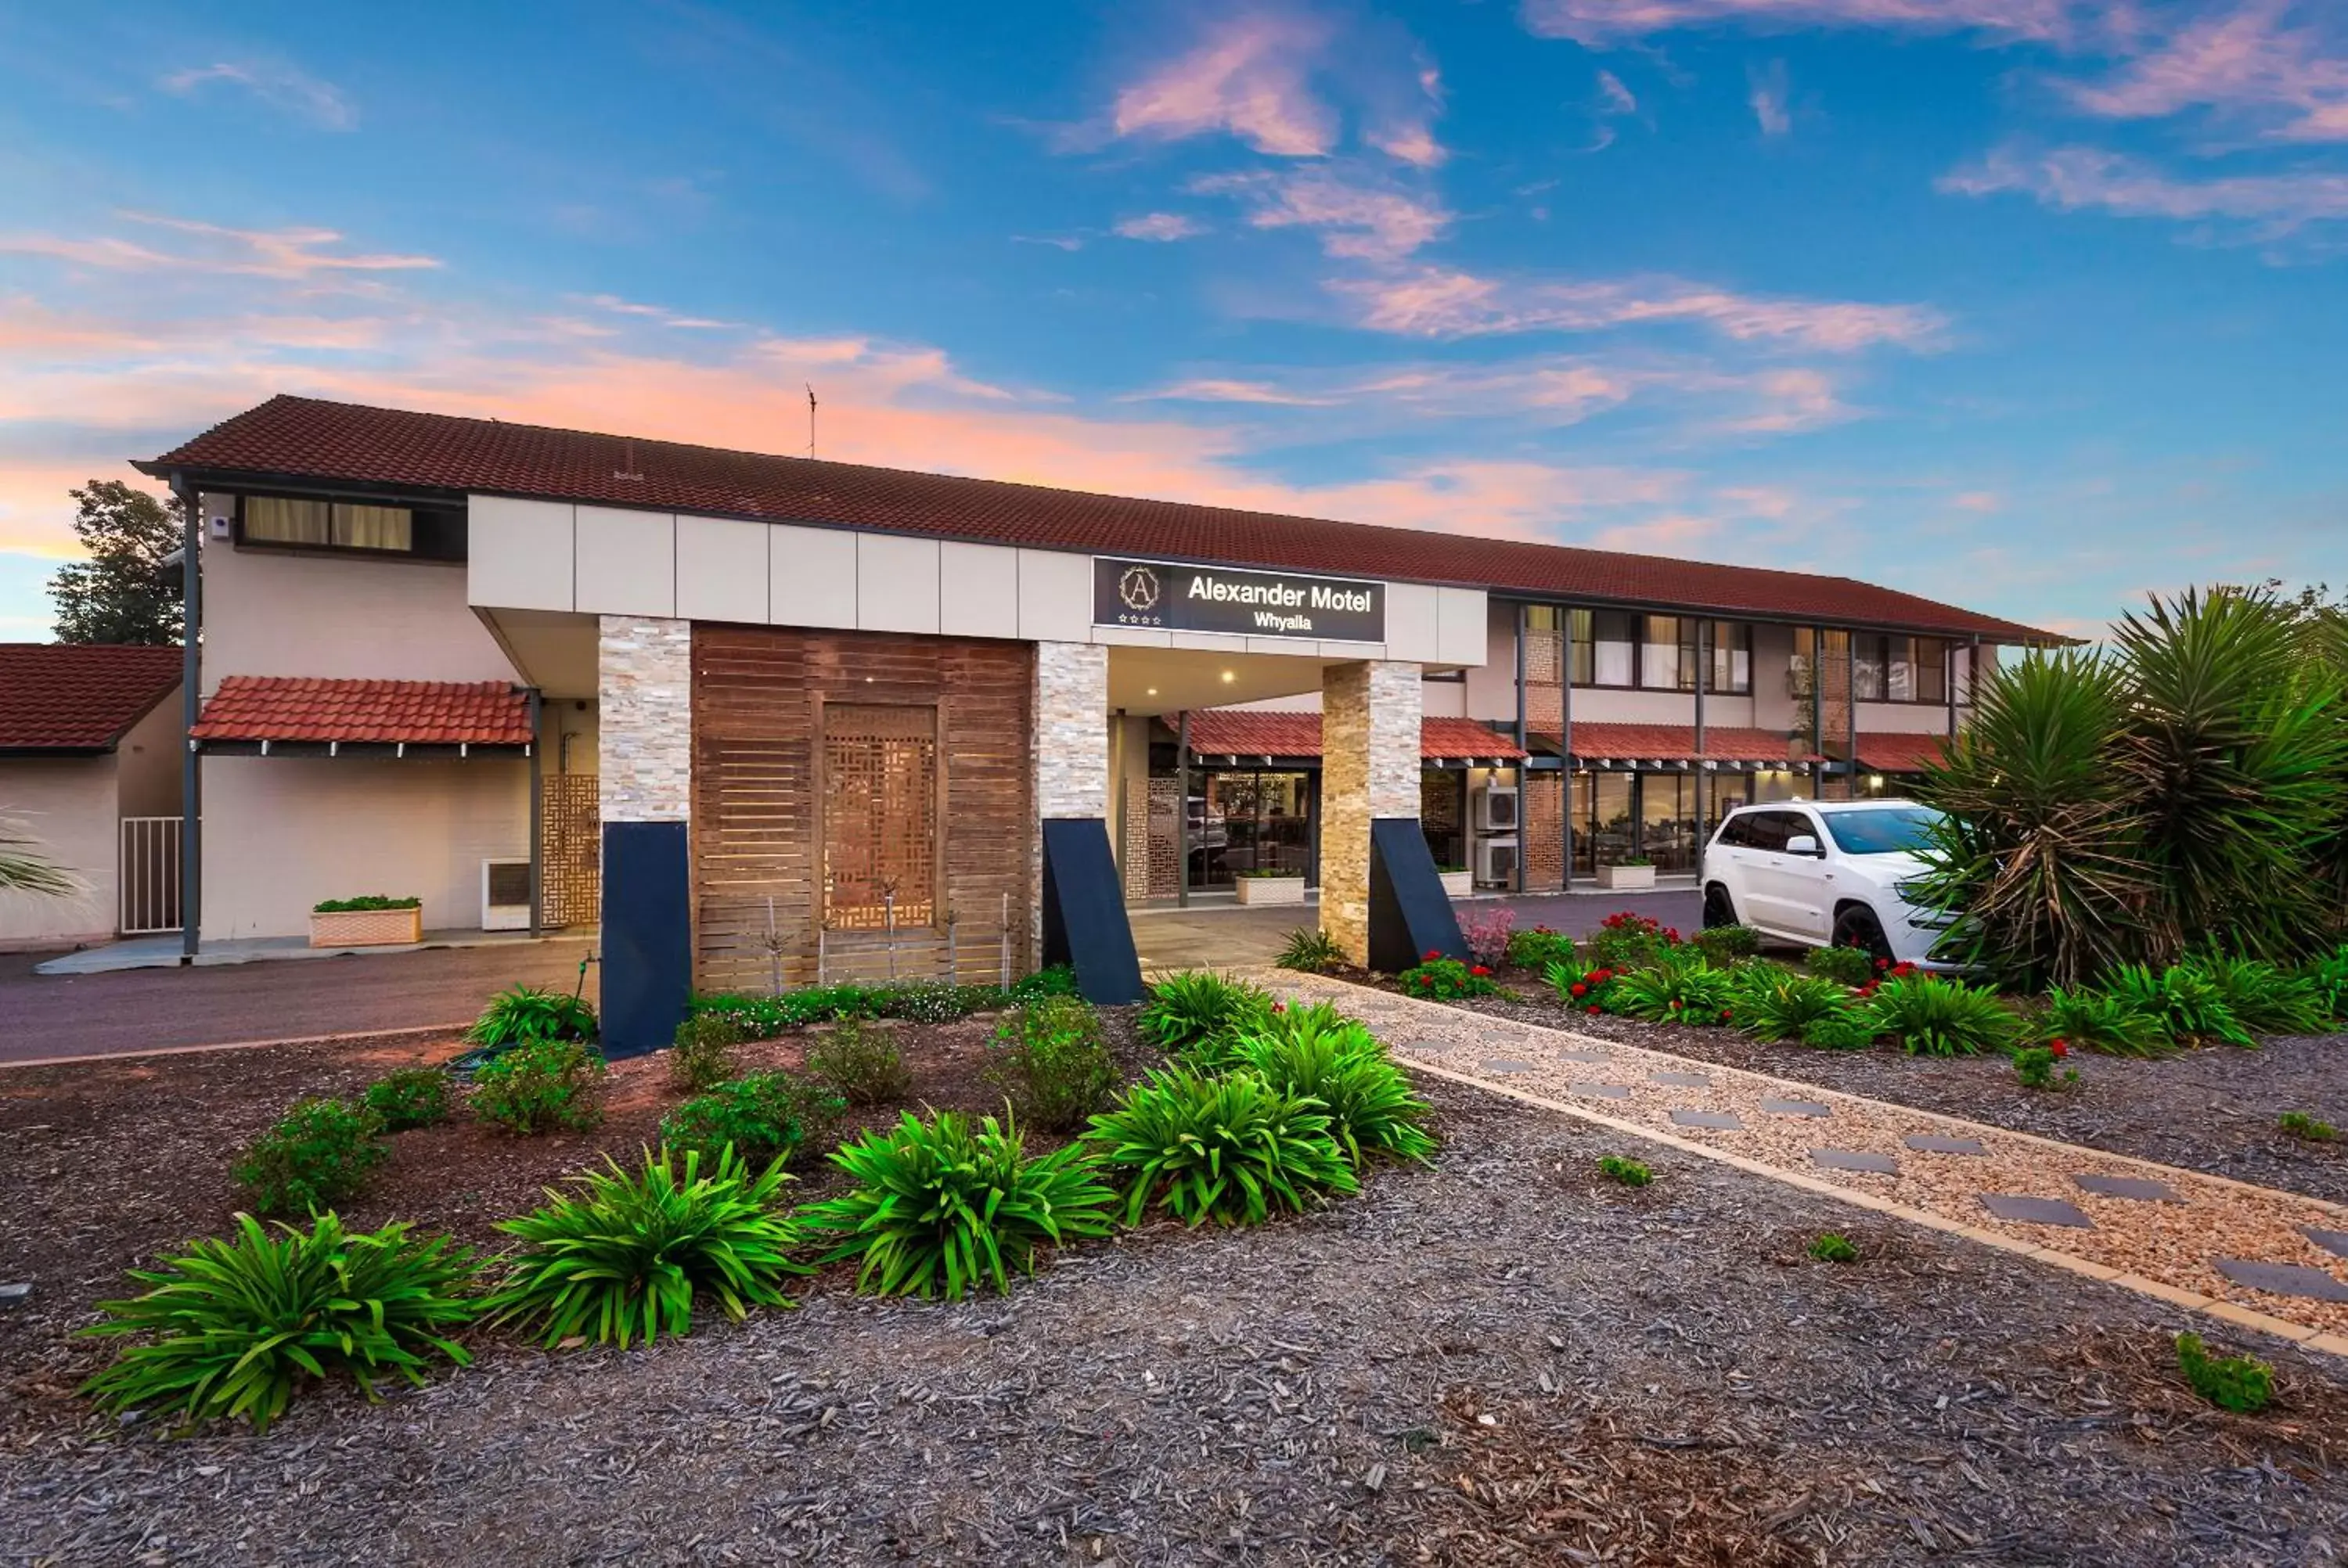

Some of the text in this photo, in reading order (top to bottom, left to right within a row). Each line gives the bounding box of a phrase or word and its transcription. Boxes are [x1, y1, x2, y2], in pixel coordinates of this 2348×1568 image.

[1129, 575, 1151, 602] A
[1188, 576, 1371, 612] Alexander Motel
[1254, 611, 1312, 631] Whyalla
